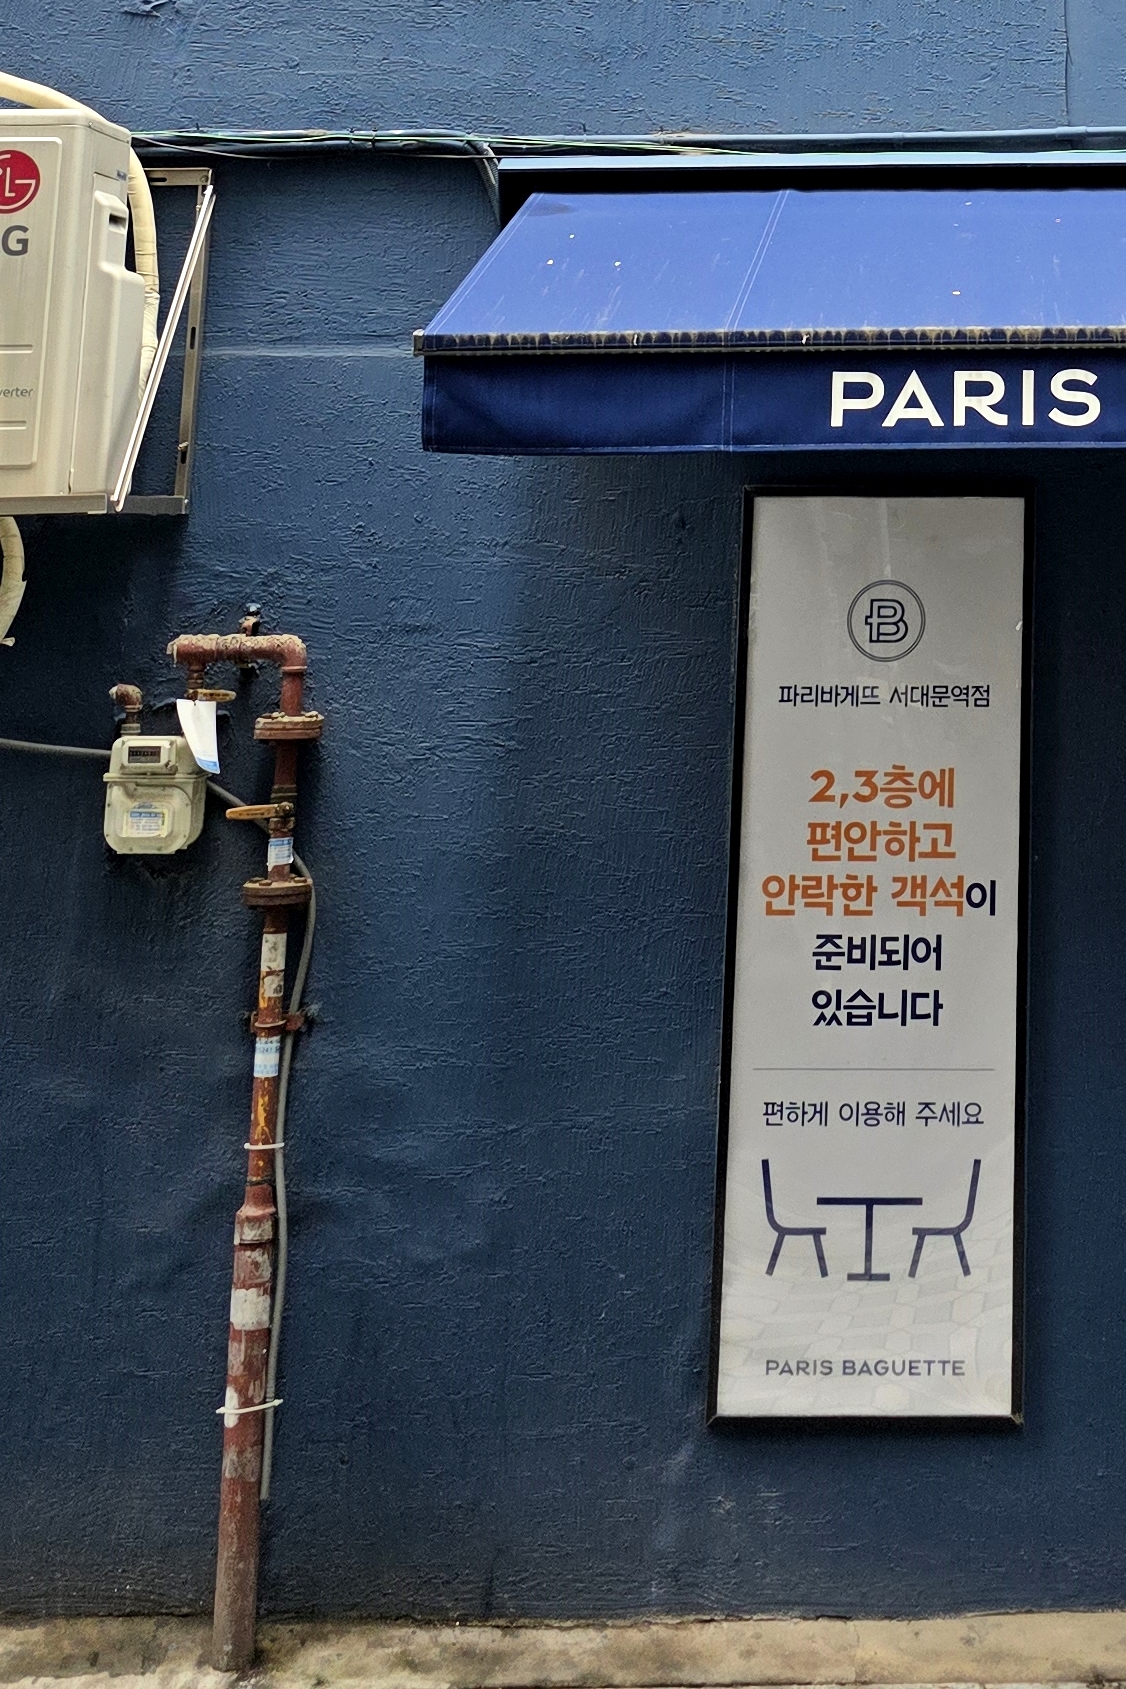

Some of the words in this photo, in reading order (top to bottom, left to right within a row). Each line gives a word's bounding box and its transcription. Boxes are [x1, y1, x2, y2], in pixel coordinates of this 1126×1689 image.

[829, 368, 1101, 428] PARIS
[777, 683, 882, 708] 파리바게뜨
[888, 683, 991, 708] 서대문역점
[808, 763, 955, 810] 2,3층에
[805, 821, 957, 863] 편안하고
[760, 873, 878, 917] 안락한
[889, 874, 997, 917] 객석이
[811, 933, 943, 972] 준비되어
[810, 988, 944, 1028] 있습니다
[762, 1100, 829, 1127] 편하게
[838, 1100, 906, 1127] 이용해
[915, 1100, 985, 1128] 주세요
[765, 1359, 834, 1377] PARIS
[842, 1359, 966, 1377] BAGUETTE
